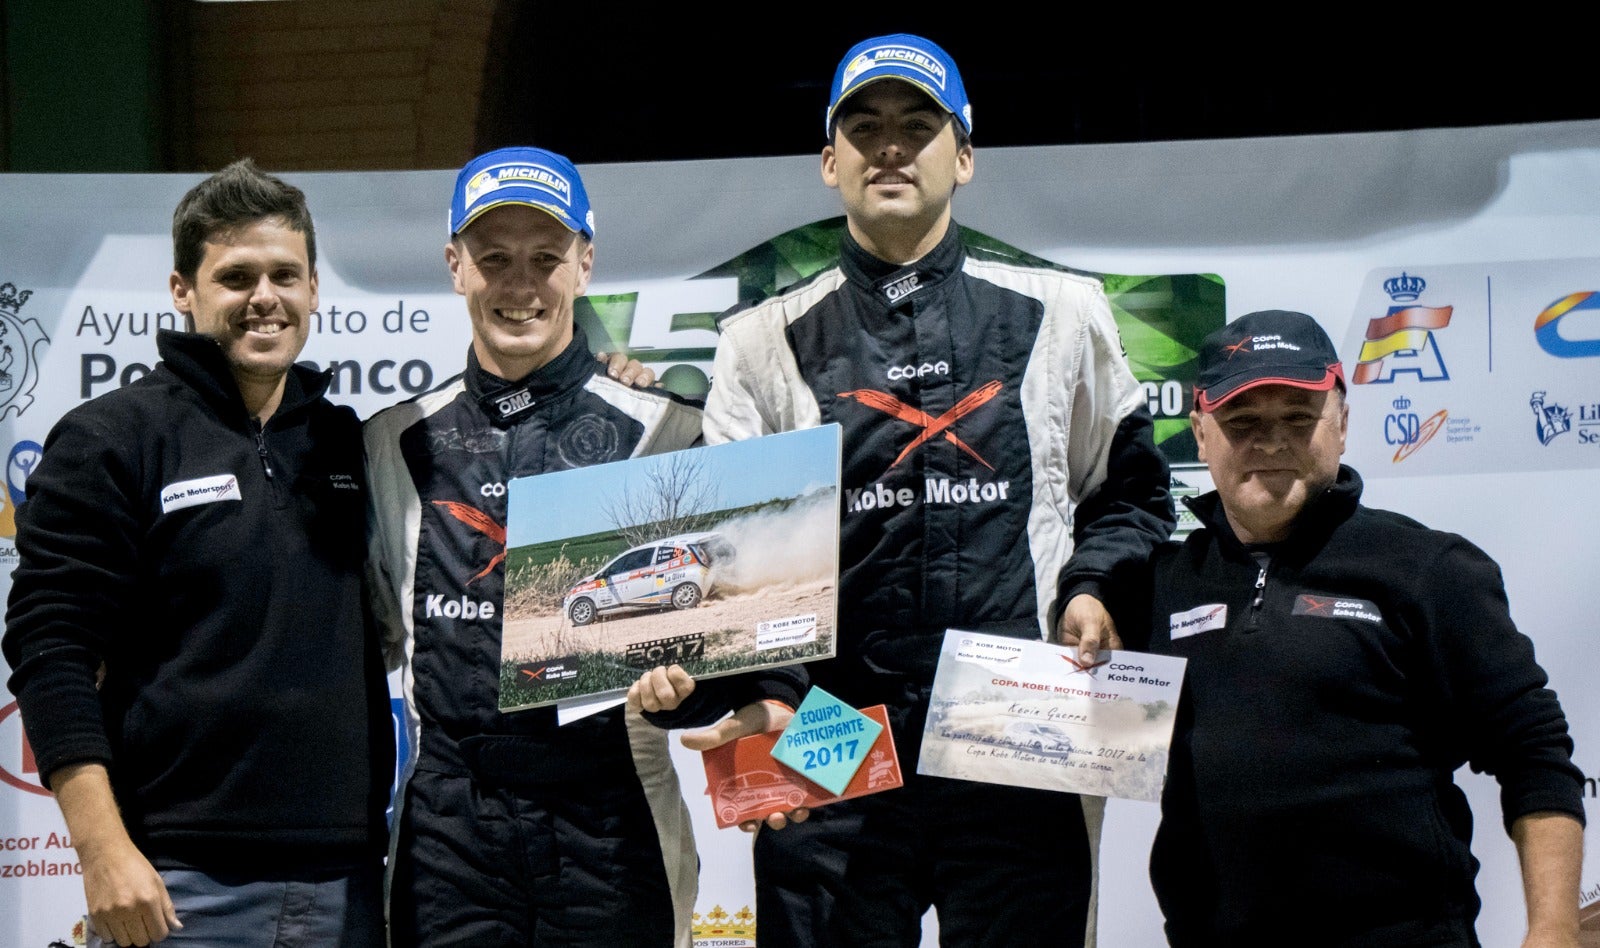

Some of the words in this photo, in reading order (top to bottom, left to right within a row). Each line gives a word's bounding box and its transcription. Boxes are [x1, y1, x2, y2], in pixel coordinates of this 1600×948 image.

[874, 49, 944, 78] MICHELIN
[498, 168, 568, 193] MICHELIN
[886, 276, 919, 300] OMP
[76, 304, 367, 345] Ayunnto
[382, 300, 430, 334] de
[1252, 334, 1281, 343] COPA
[1253, 341, 1277, 351] Kobe
[887, 361, 949, 381] COPA
[499, 388, 532, 413] OMP
[1140, 380, 1183, 416] CO
[1384, 413, 1420, 446] CSD
[1578, 429, 1600, 445] Se
[163, 492, 185, 504] Kobe
[186, 483, 232, 497] Motorsport
[480, 482, 506, 498] CO
[845, 482, 915, 513] Kobe
[925, 478, 1009, 504] Motor
[426, 594, 495, 620] Kobe
[1334, 601, 1364, 609] COPA
[772, 621, 790, 629] KOBE
[791, 616, 816, 626] MOTOR
[1333, 608, 1355, 617] Kobe
[1355, 610, 1382, 623] Motor
[996, 645, 1022, 653] MOTOR
[1109, 663, 1145, 672] COPA
[991, 678, 1019, 688] COPA
[1022, 682, 1051, 691] KOBE
[1053, 686, 1092, 697] MOTOR
[1094, 691, 1119, 700] 2017
[1107, 673, 1136, 684] Kobe
[1138, 675, 1171, 687] Motor
[801, 704, 842, 726] EQUIPO
[1007, 702, 1040, 714] Kevin
[1047, 706, 1088, 721] Guerra
[786, 717, 865, 748] PARTICIPANTE
[803, 739, 860, 770] 2017
[966, 744, 986, 758] Copa
[989, 747, 1009, 759] Kobe
[1011, 750, 1035, 762] Motor
[1097, 747, 1125, 759] 2017
[710, 939, 747, 948] TORRES
